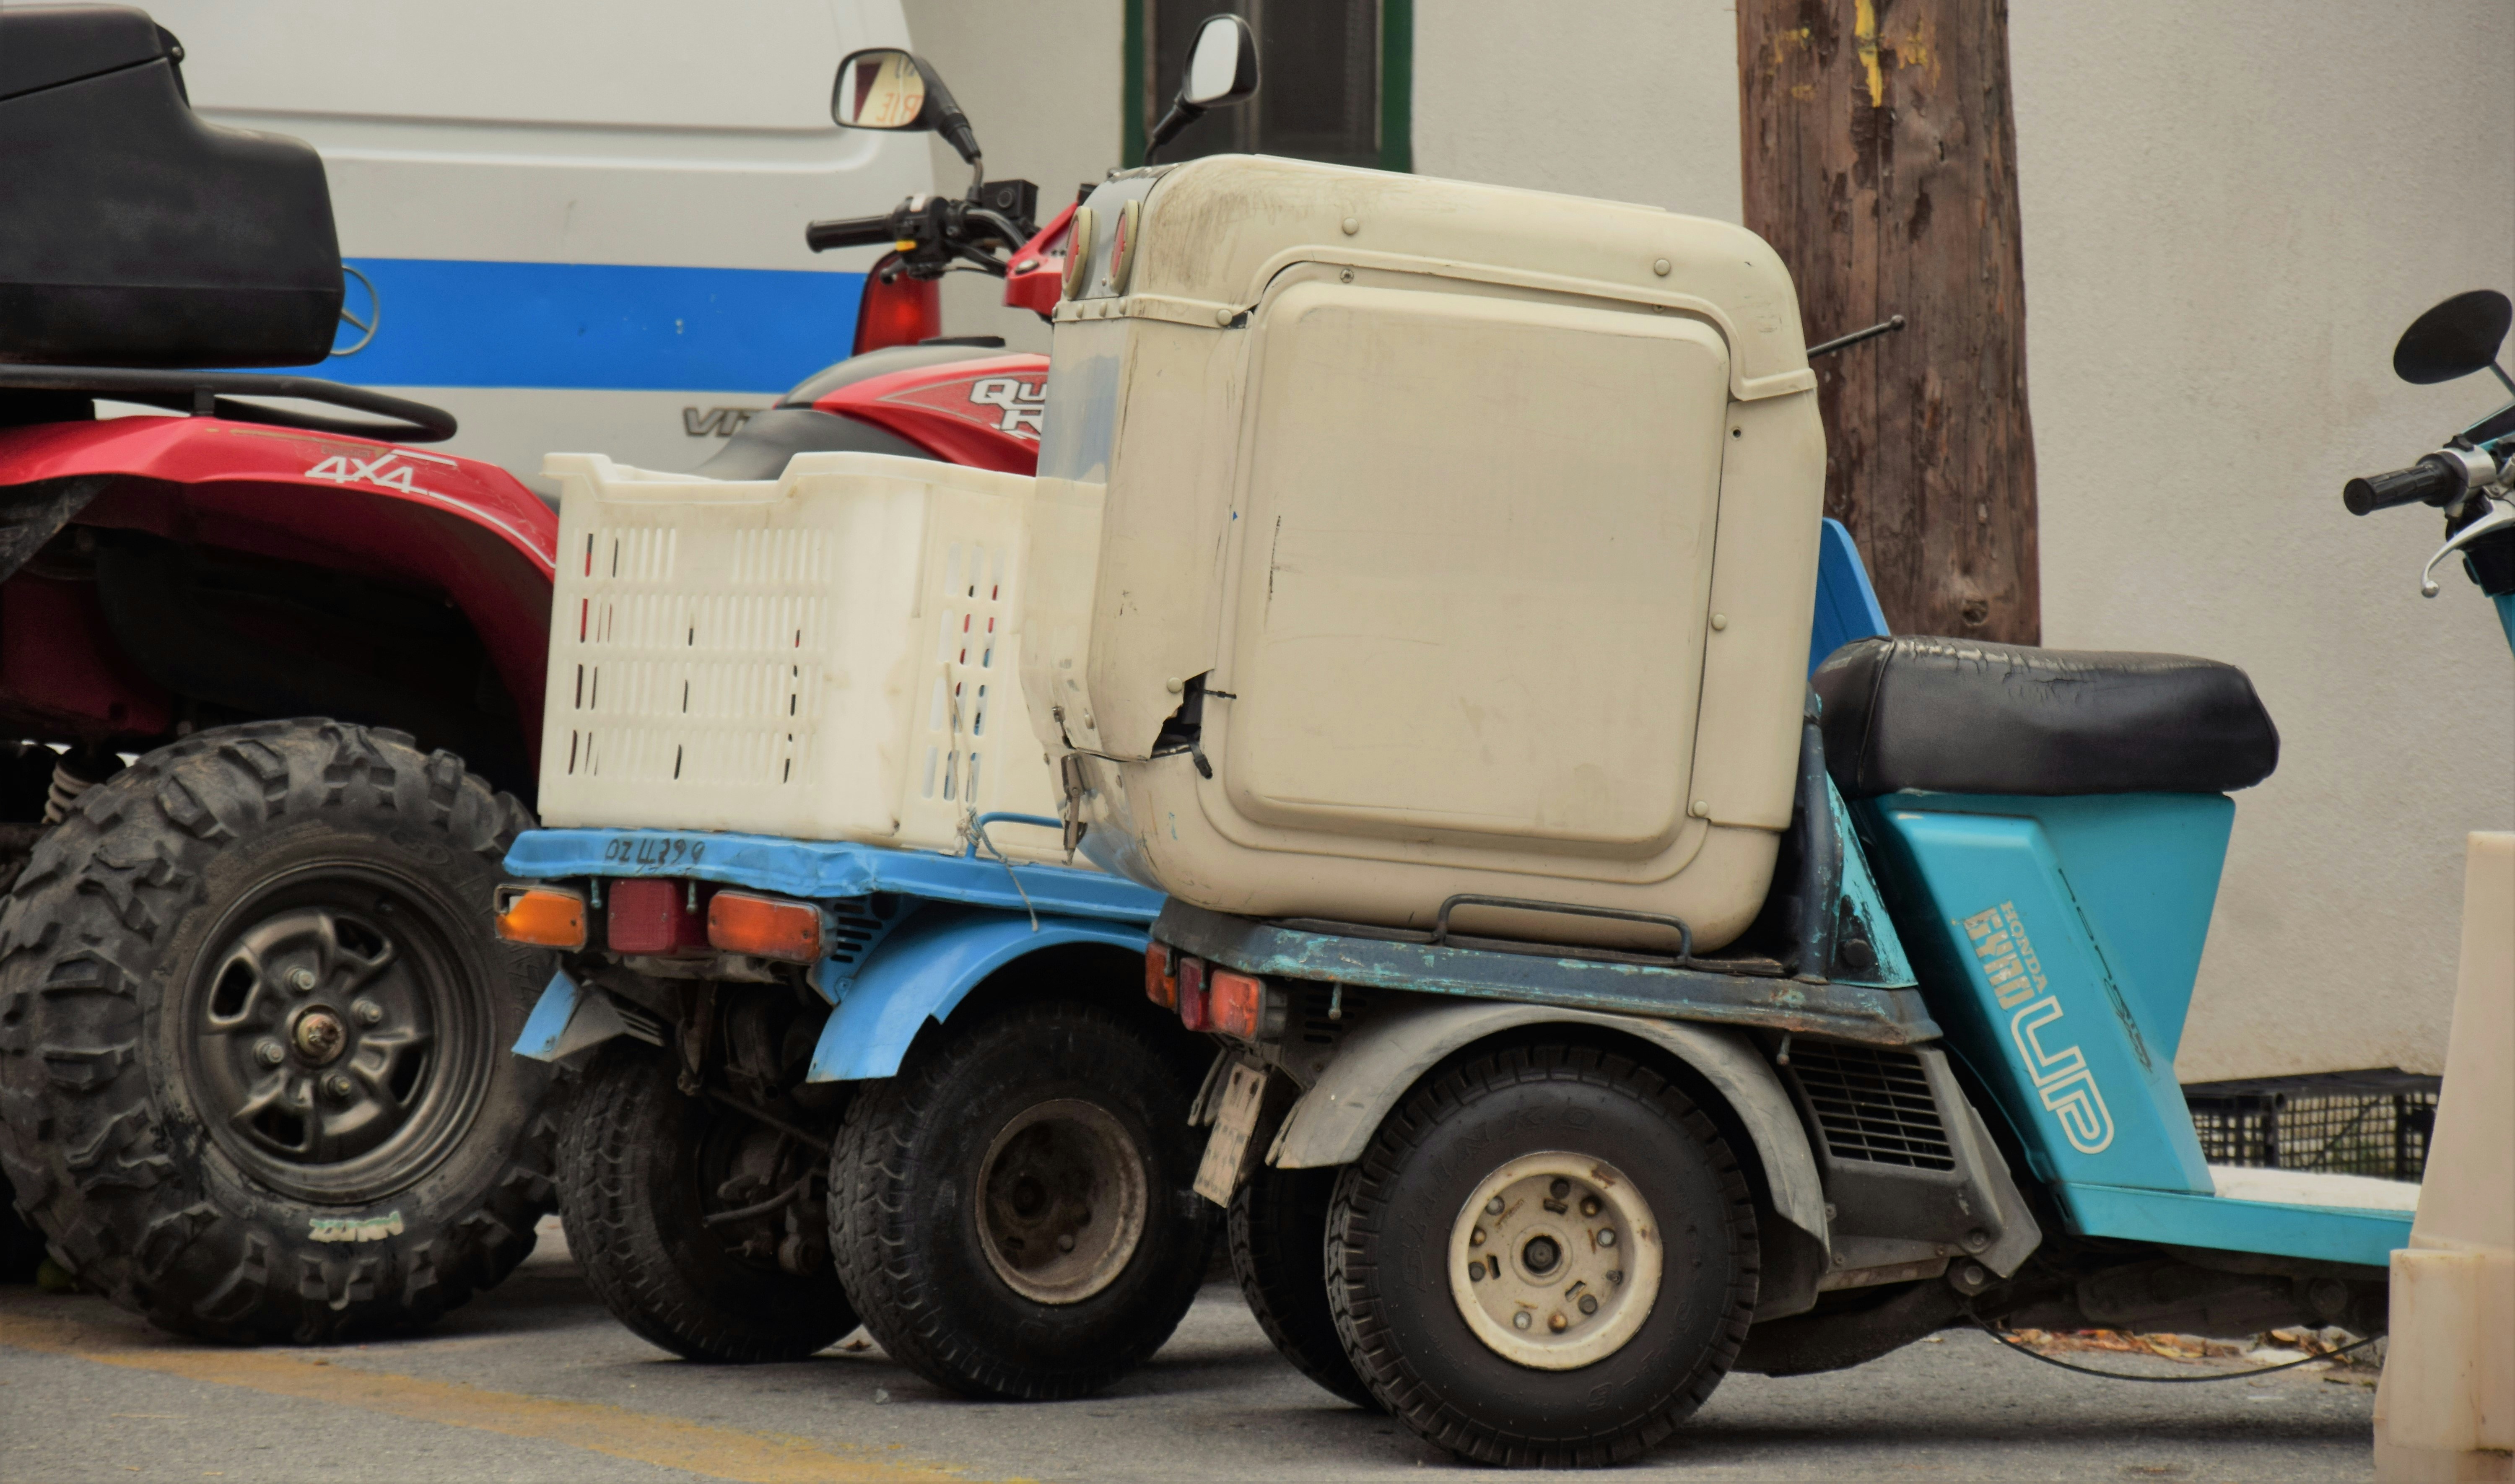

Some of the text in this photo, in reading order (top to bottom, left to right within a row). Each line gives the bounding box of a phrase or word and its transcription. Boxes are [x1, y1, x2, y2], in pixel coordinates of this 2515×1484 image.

[305, 449, 424, 494] 4X4
[1962, 906, 2035, 1010] GYRO
[2000, 899, 2048, 994] HONDA
[2011, 995, 2115, 1155] UP
